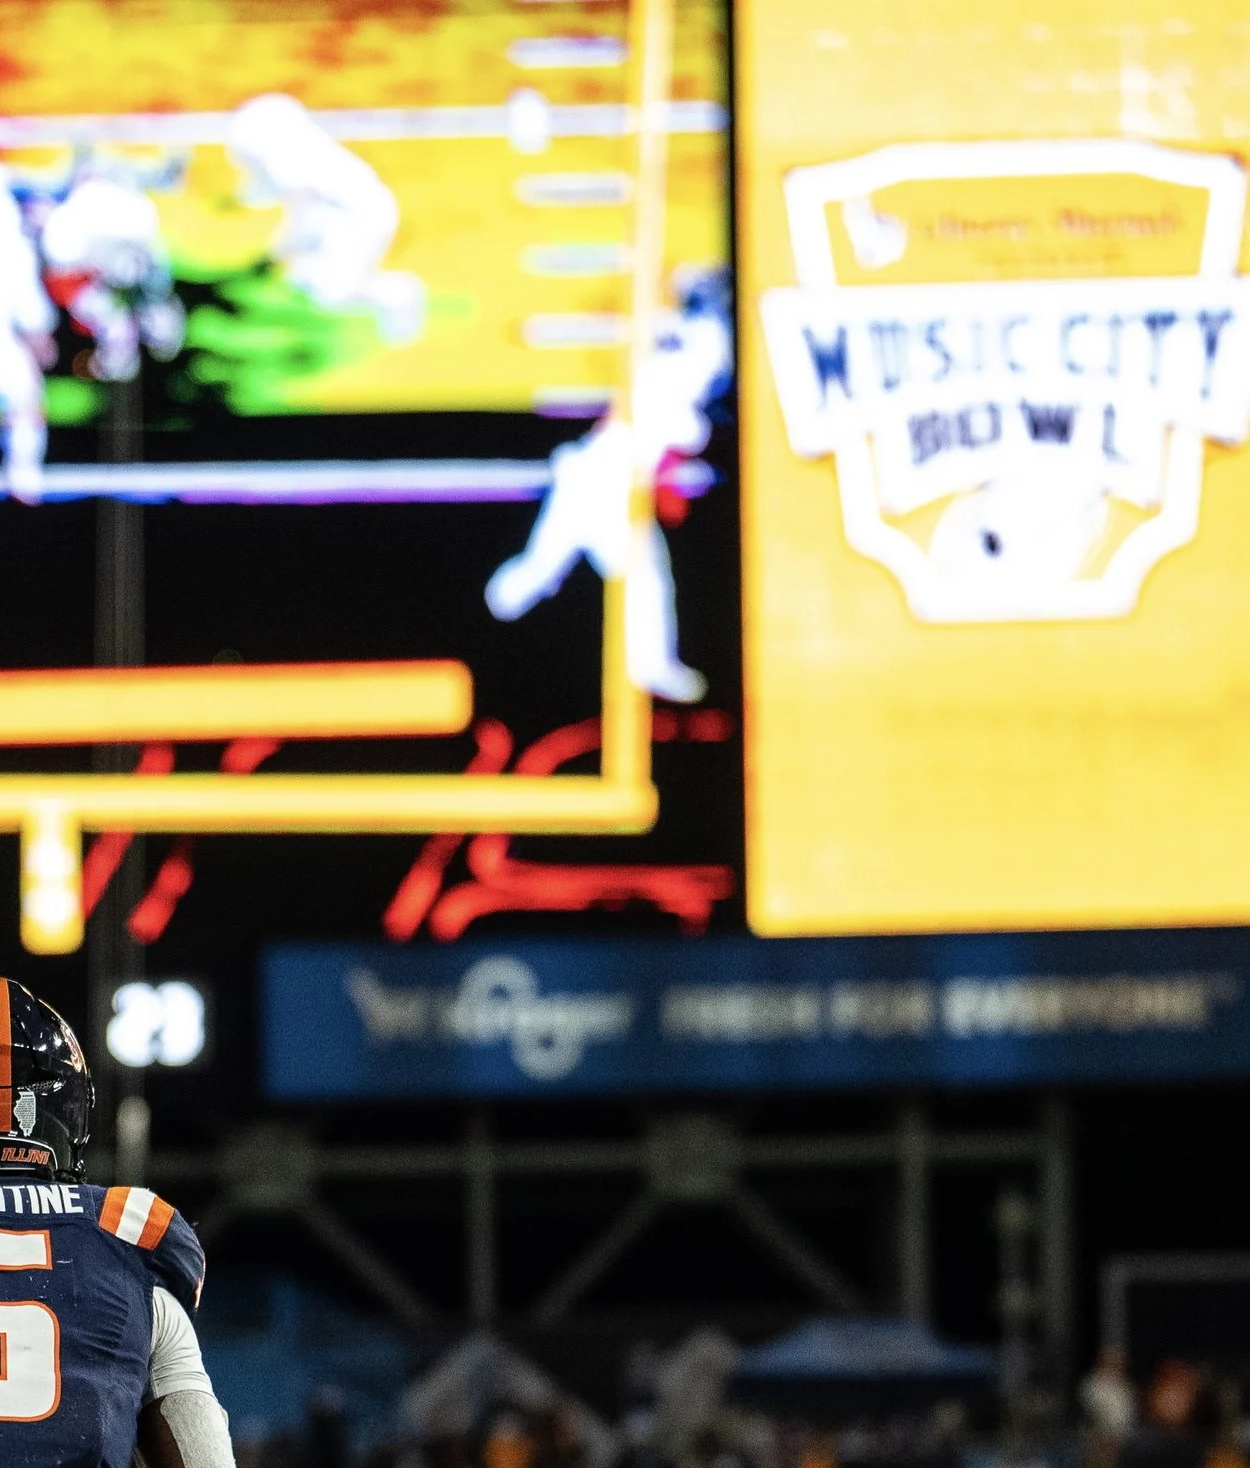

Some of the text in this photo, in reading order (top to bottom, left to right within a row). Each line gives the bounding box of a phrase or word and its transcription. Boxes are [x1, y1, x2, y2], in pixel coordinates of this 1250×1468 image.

[1059, 305, 1237, 402] CITY
[907, 397, 1132, 466] BOWL
[1, 1147, 50, 1166] ILLINI
